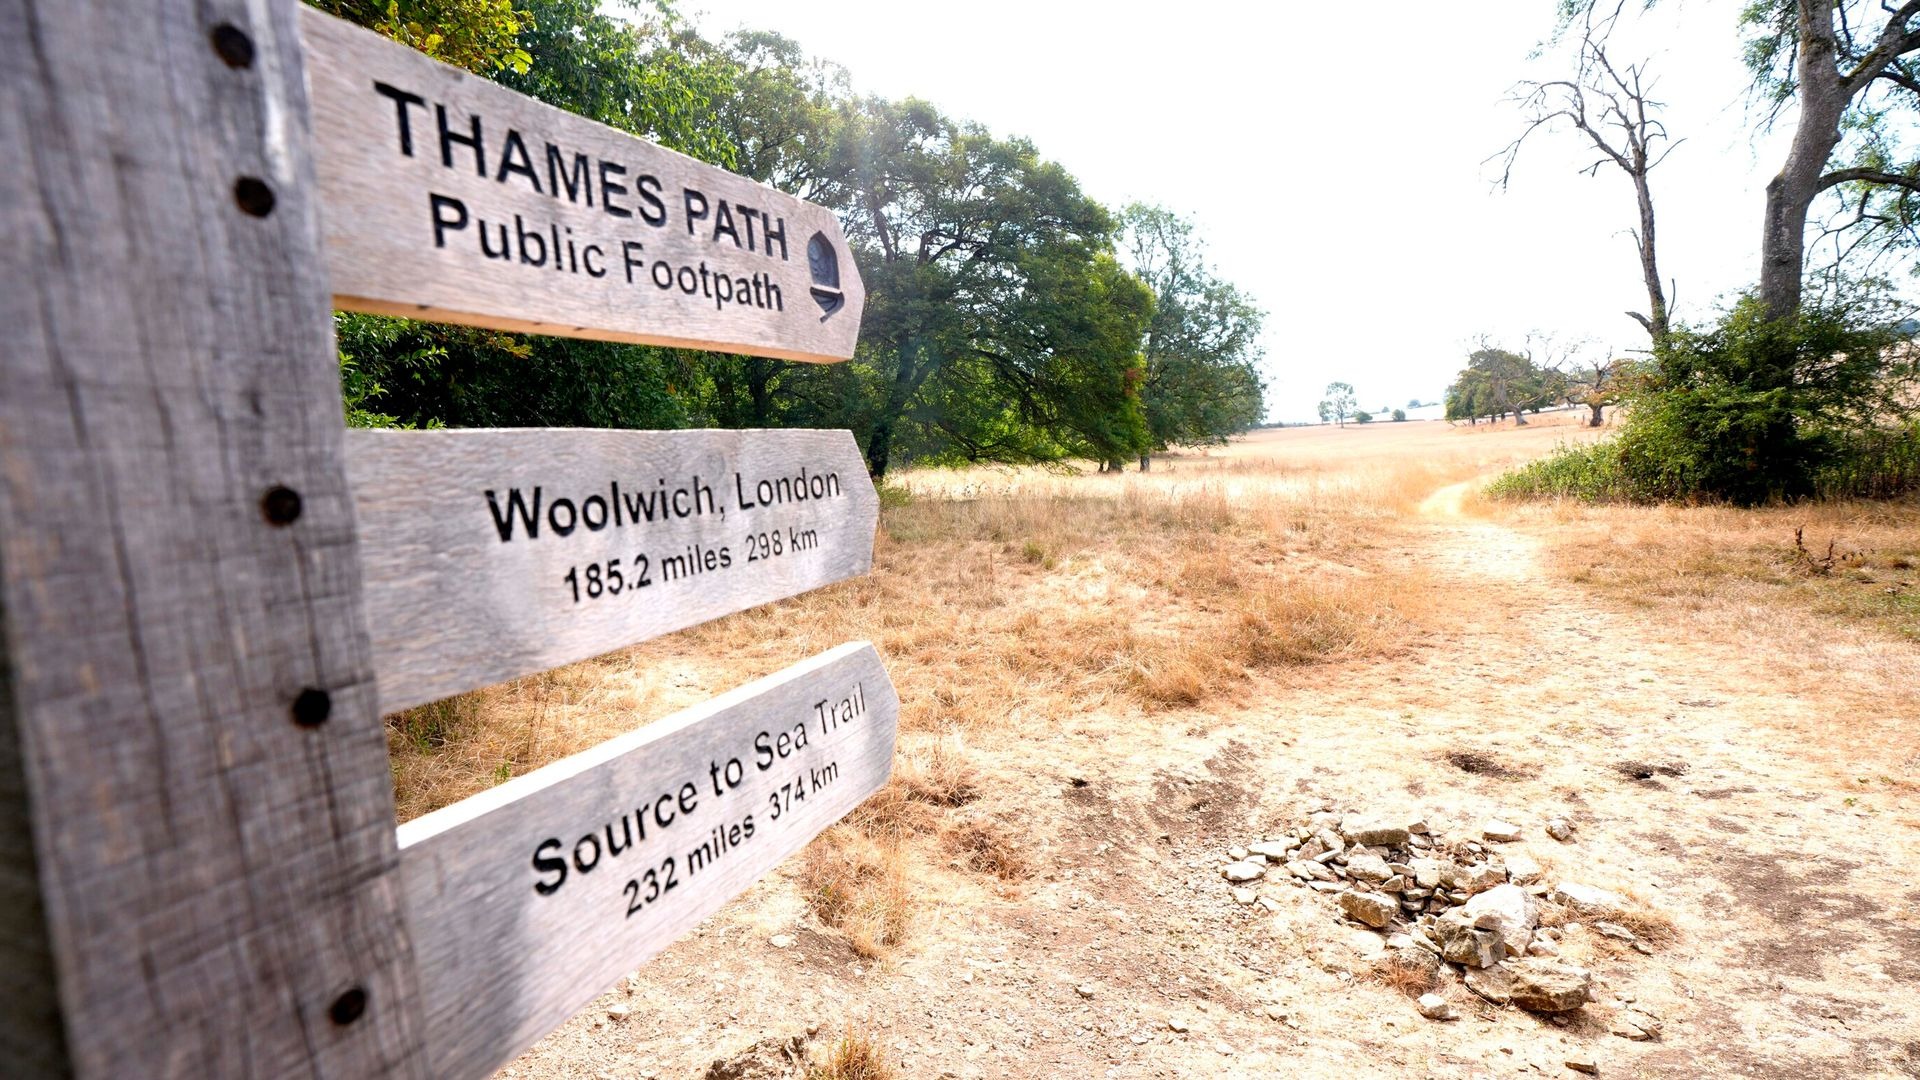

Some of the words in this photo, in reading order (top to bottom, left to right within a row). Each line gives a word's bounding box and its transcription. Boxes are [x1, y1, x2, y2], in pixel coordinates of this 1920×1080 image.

[374, 80, 666, 228] THAMES
[683, 187, 789, 262] PATH
[429, 192, 607, 278] Public
[622, 240, 783, 311] Footpath
[484, 474, 727, 543] Woolwich,
[735, 467, 841, 511] London
[565, 553, 652, 603] 185.2
[662, 543, 732, 583] miles
[746, 530, 783, 563] 298
[790, 526, 819, 552] km
[532, 782, 699, 897] Source
[710, 756, 744, 797] to
[754, 722, 807, 772] Sea
[814, 681, 867, 735] Trail
[623, 856, 679, 920] 232
[687, 812, 756, 877] miles
[769, 775, 807, 822] 374
[811, 758, 840, 796] km
